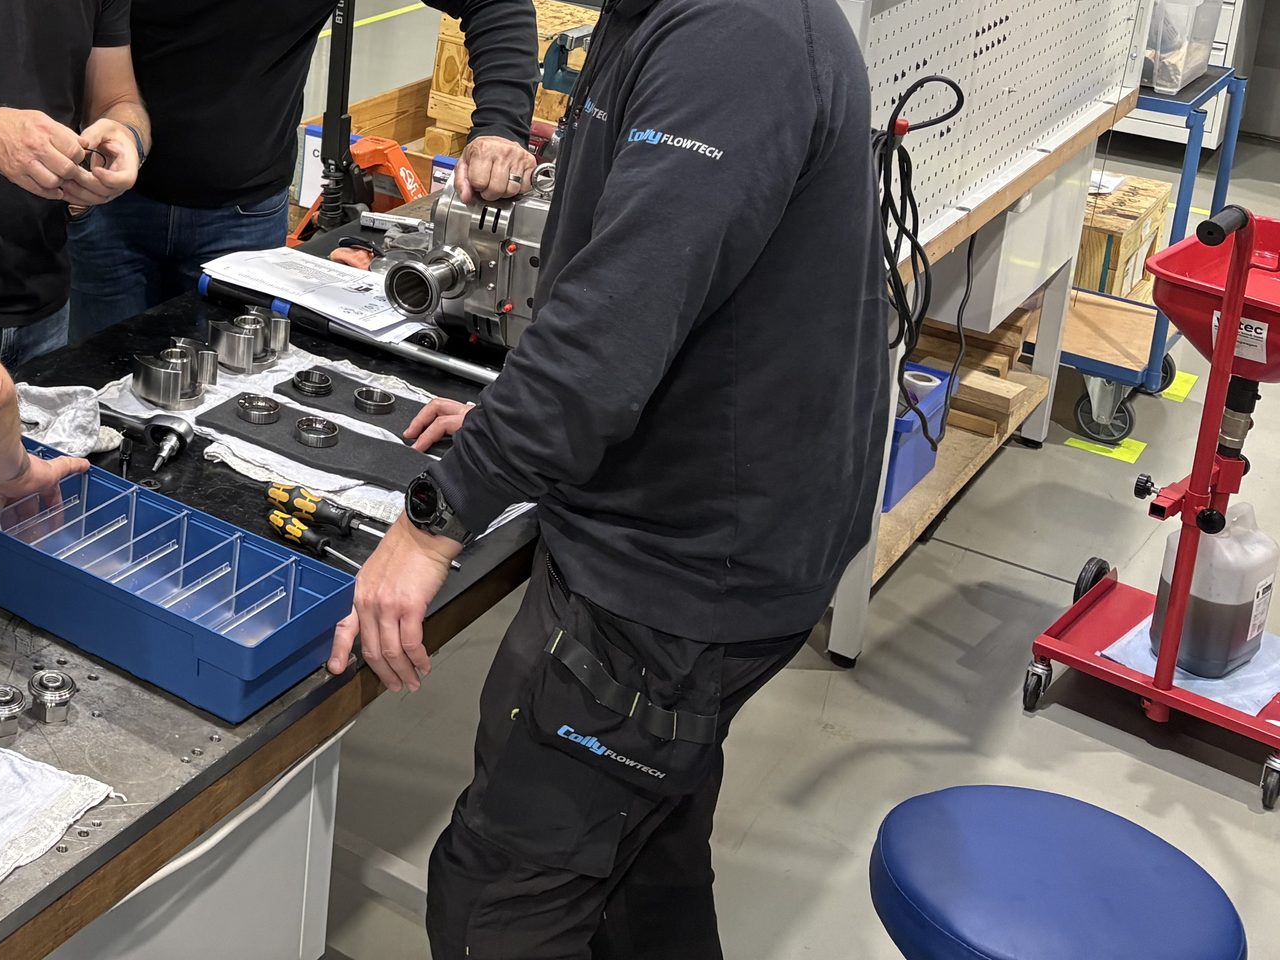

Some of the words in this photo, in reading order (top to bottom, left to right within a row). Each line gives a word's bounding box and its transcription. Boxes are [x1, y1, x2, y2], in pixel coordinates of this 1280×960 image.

[627, 127, 663, 145] Colly
[661, 133, 725, 161] FLOWTECH
[556, 724, 608, 757] Colly
[604, 749, 667, 780] FLOWTECH
